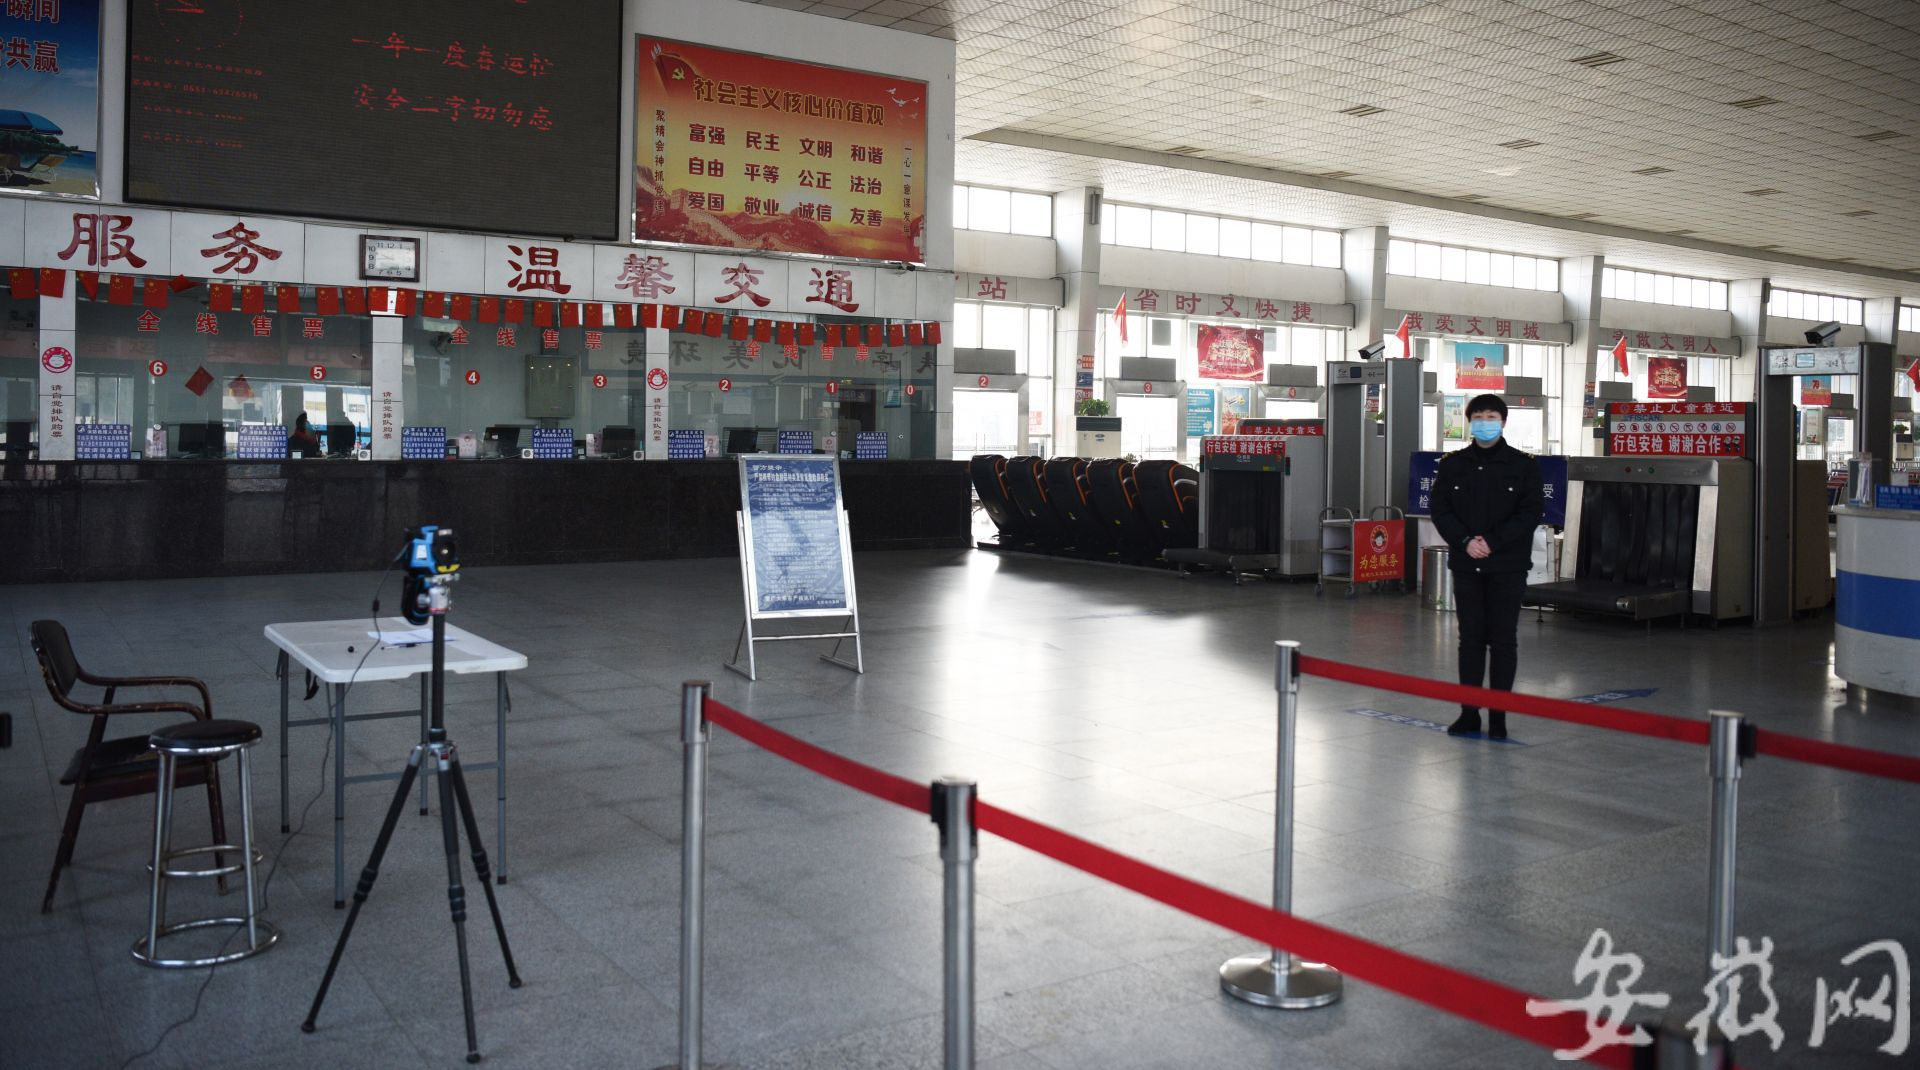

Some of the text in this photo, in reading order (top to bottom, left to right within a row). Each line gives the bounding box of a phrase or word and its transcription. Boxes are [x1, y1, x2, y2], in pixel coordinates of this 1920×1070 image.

[0, 0, 60, 23] 瞬间
[0, 36, 60, 74] 共赢
[352, 32, 554, 79] 一年一度春运忙
[354, 83, 552, 130] 安全二字切勿忘
[694, 77, 884, 126] 社会主义核心价值观
[689, 123, 883, 164] 富强 民主 文明 和谐
[688, 156, 882, 195] 自由 平等 公正 法治
[687, 191, 882, 227] 爱国 敬业 诚信 友善
[57, 212, 860, 314] 服务 温馨交通
[977, 276, 1008, 300] 站
[1133, 288, 1313, 323] 省时又快捷
[137, 309, 324, 339] 全线售票
[1406, 312, 1540, 340] 我爱文明城
[450, 325, 603, 350] 全线售票
[745, 338, 870, 362] 全线售票
[153, 361, 163, 375] 6
[313, 366, 323, 380] 5
[468, 372, 477, 384] 4
[596, 375, 604, 387] 3
[721, 380, 729, 391] 2
[51, 384, 63, 437] 请自觉排队购票
[1634, 403, 1735, 413] 禁止儿童靠近
[1254, 426, 1316, 434] 禁止儿童靠近
[1207, 441, 1272, 454] 行包安检 谢谢合作
[1613, 434, 1721, 454] 行包安检 谢谢合作
[1543, 483, 1554, 499] 受
[1360, 553, 1398, 569] 为您服务
